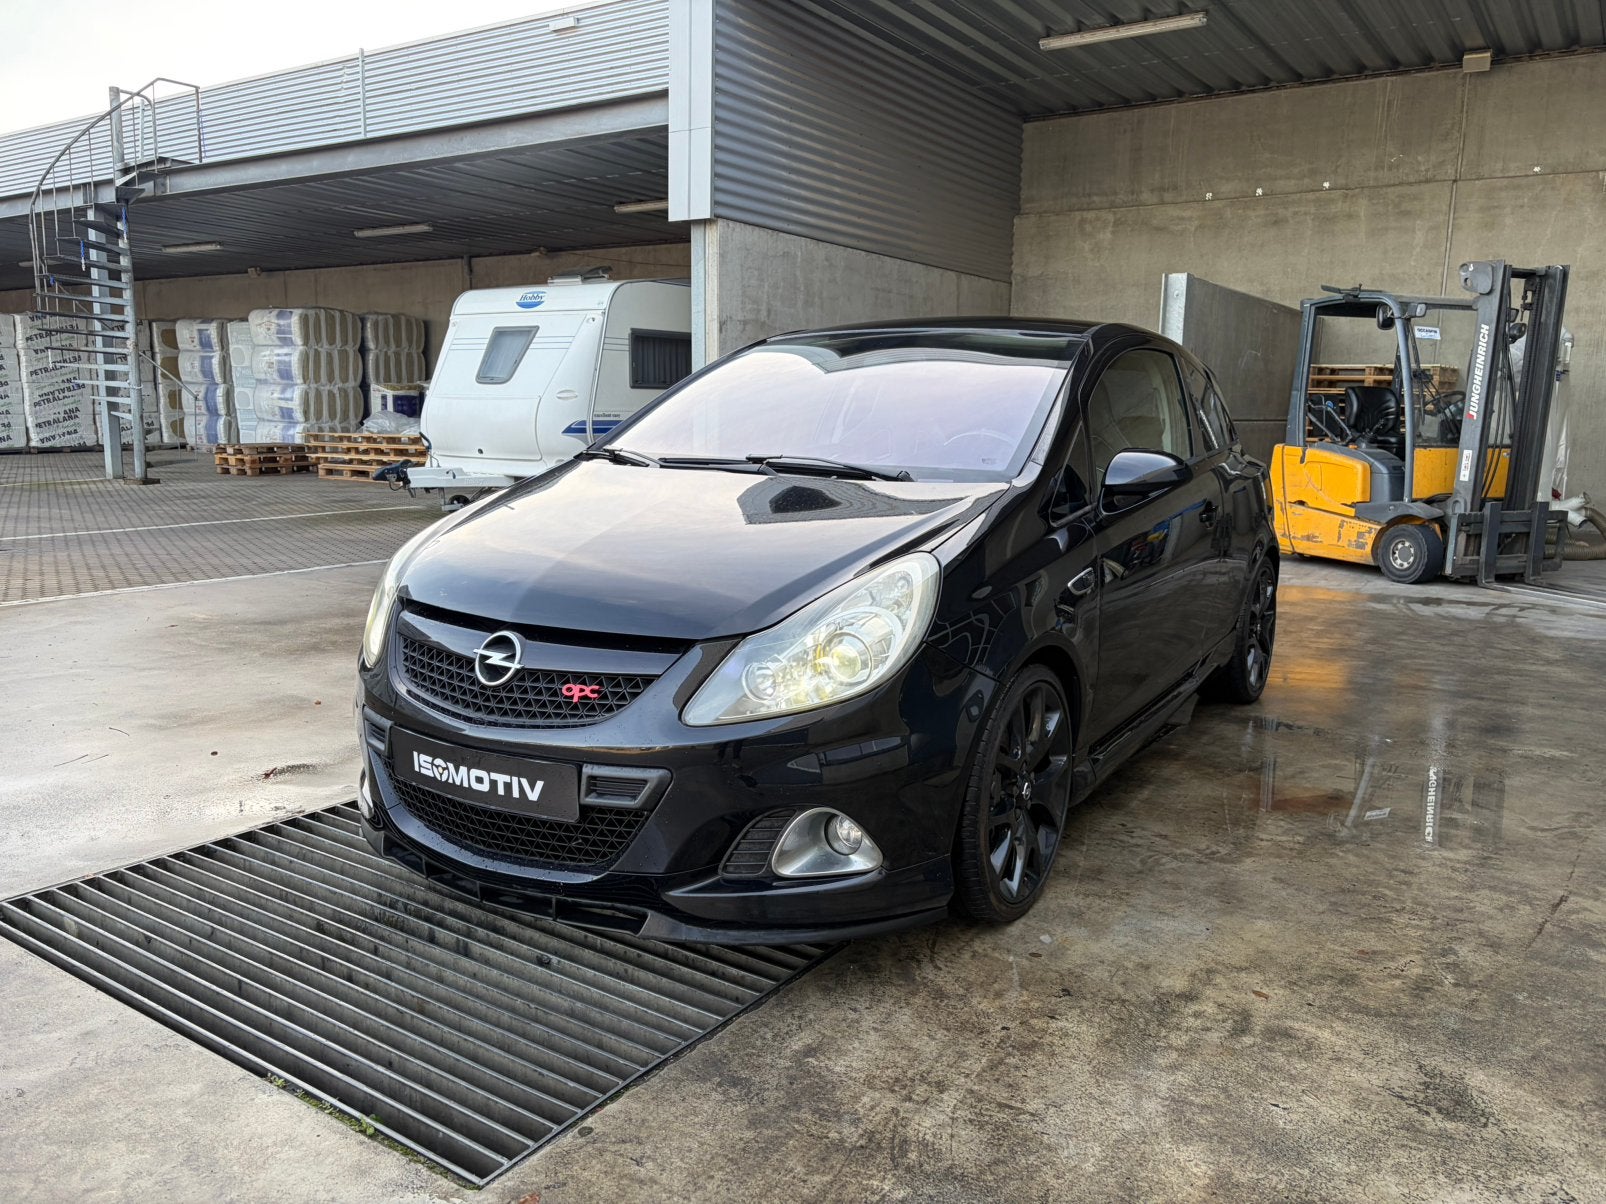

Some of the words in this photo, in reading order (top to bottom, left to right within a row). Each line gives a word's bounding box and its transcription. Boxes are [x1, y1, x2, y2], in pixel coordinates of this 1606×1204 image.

[519, 293, 545, 303] Hobby
[1466, 323, 1490, 419] JUNGHEINRICH
[33, 395, 77, 409] PETRALA
[412, 751, 545, 802] ISOMOTIV
